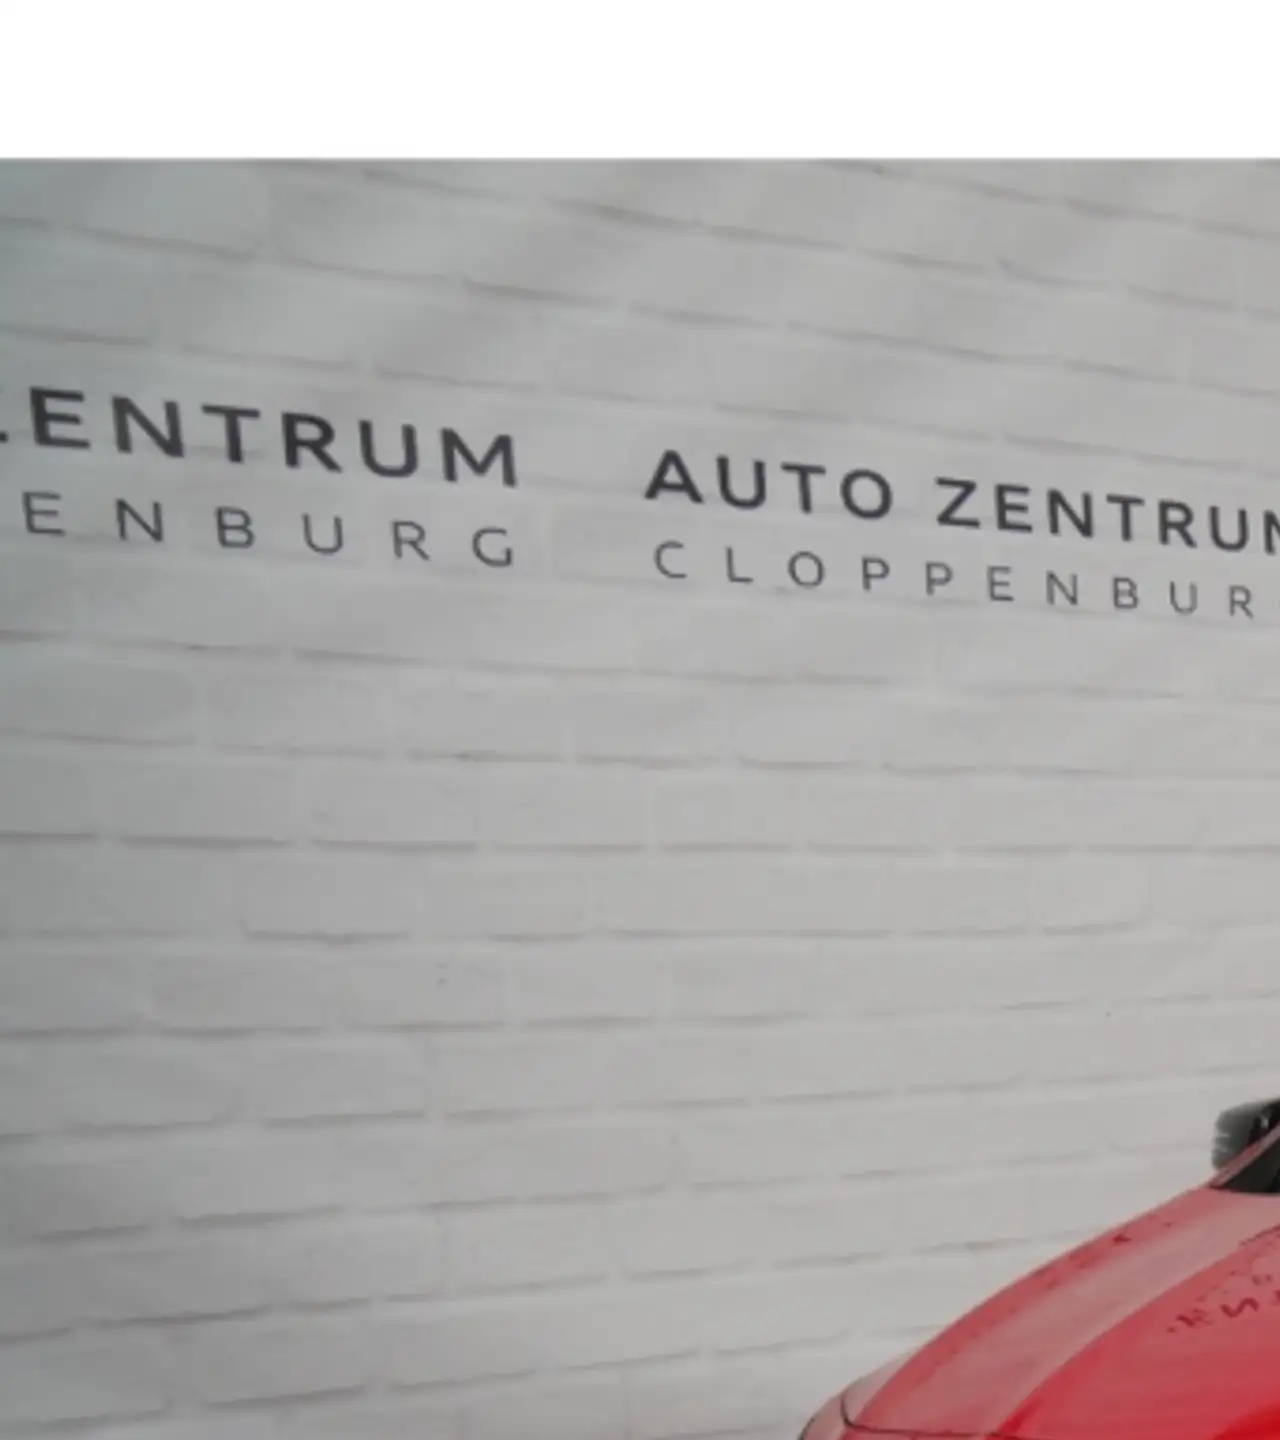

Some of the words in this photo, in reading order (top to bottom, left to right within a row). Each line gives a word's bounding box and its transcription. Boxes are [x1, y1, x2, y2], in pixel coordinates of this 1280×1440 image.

[0, 384, 519, 489] ENTRUM
[643, 448, 894, 522] AUTO
[21, 490, 514, 569] ENBURG
